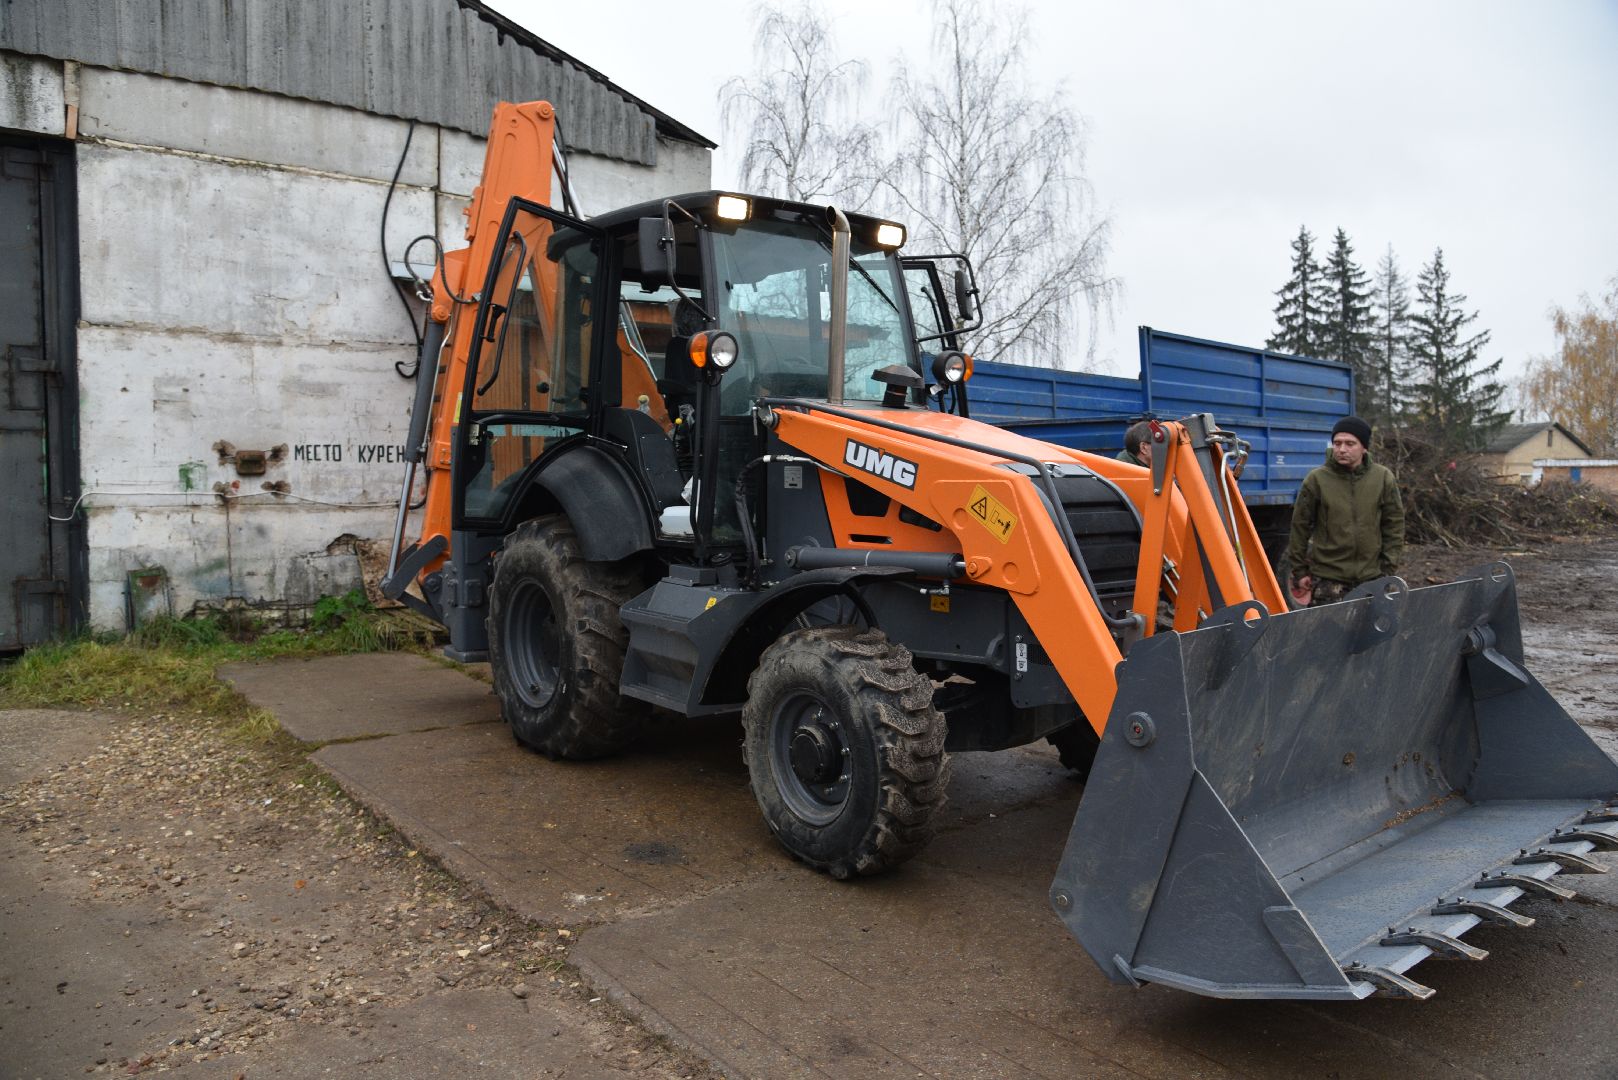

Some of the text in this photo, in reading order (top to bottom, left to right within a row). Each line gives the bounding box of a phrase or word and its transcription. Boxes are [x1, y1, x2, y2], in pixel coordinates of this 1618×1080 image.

[294, 444, 420, 463] МЕСТО КУРЕН
[845, 440, 916, 487] UMG
